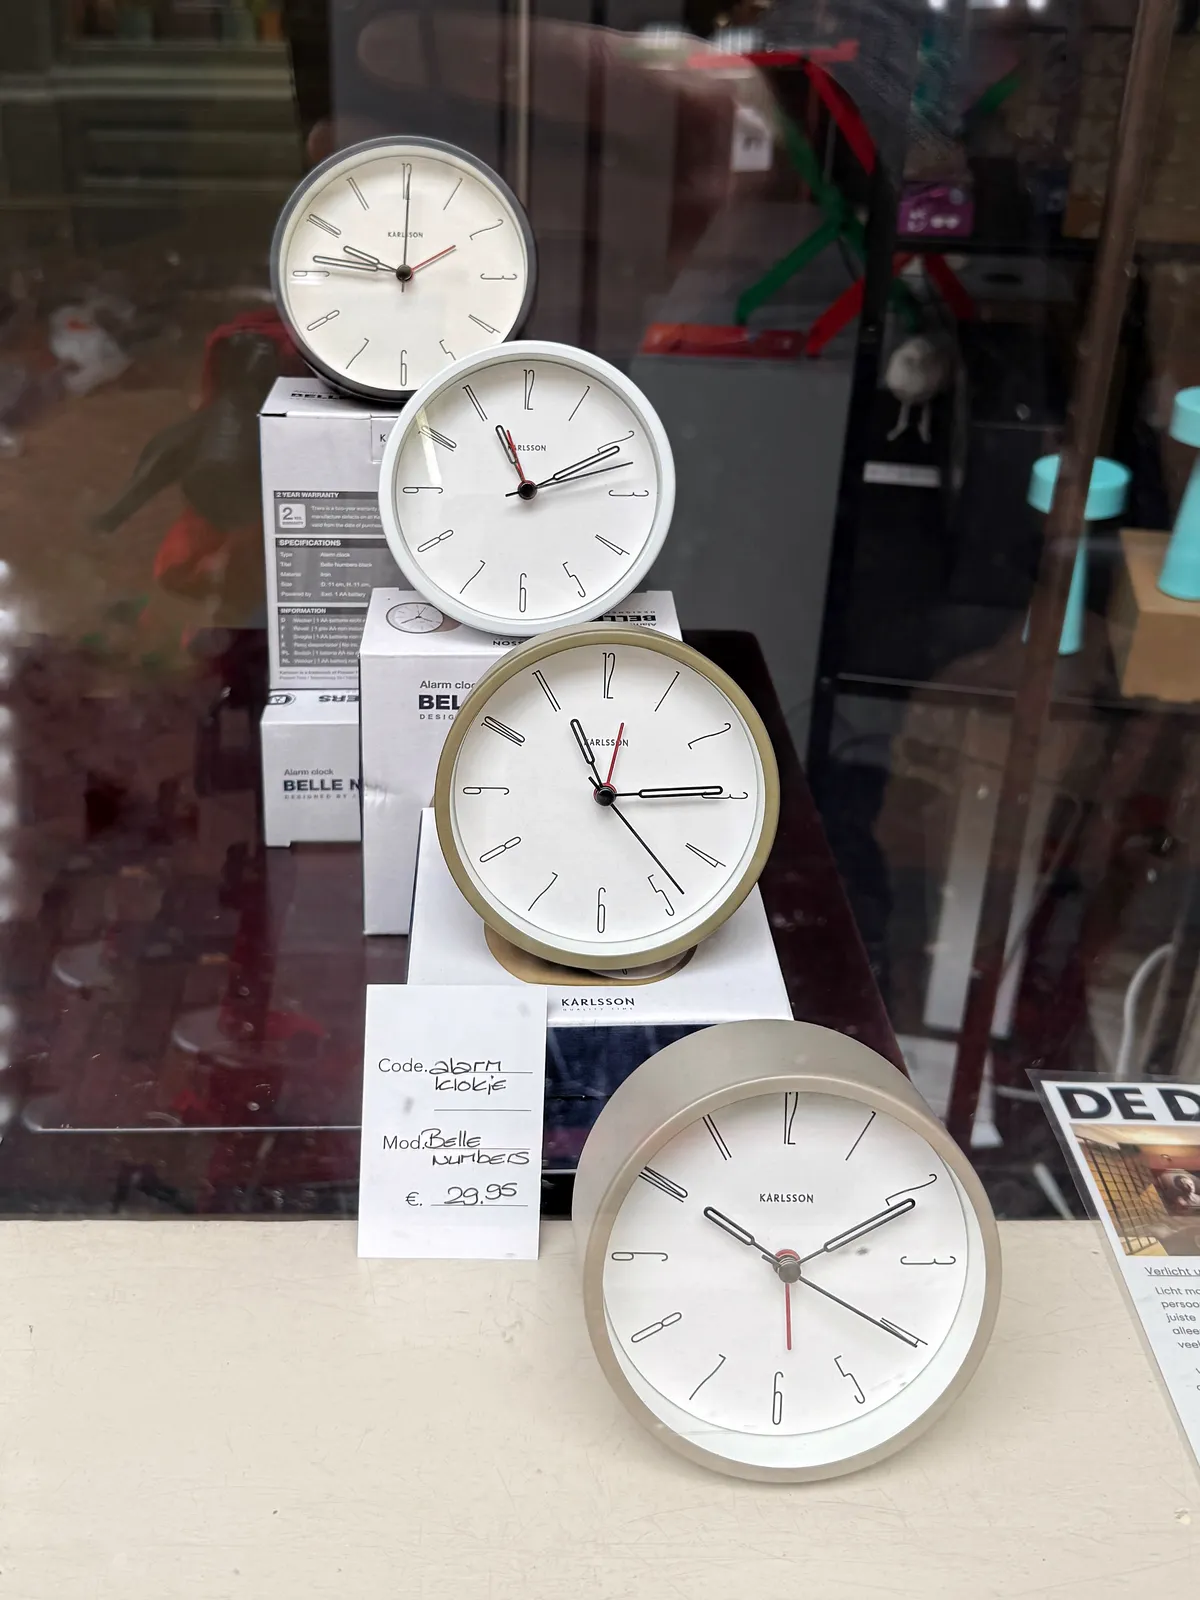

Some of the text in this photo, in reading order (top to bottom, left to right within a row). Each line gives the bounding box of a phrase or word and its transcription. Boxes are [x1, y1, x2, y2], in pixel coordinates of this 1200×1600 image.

[402, 163, 412, 200] 12
[443, 178, 463, 211] 1
[306, 213, 342, 239] 10
[469, 219, 504, 241] 2
[292, 270, 330, 278] 9
[306, 309, 340, 332] 8
[468, 314, 501, 334] 4
[345, 337, 370, 370] 7
[400, 349, 408, 387] 6
[462, 384, 488, 422] 11
[523, 369, 535, 411] 12
[568, 385, 591, 422] 1
[418, 425, 457, 452] 10
[597, 430, 635, 453] 2
[402, 486, 444, 495] 9
[608, 489, 650, 497] 3
[282, 507, 294, 520] 2
[279, 539, 342, 547] SPECIFICATIONS
[417, 529, 454, 553] 8
[594, 534, 631, 556] 4
[459, 559, 486, 595] 7
[562, 561, 586, 598] 5
[519, 572, 528, 613] 6
[419, 680, 452, 689] Alarm
[602, 652, 616, 700] 12
[418, 694, 461, 710] BEL
[531, 669, 562, 713] 11
[654, 670, 681, 713] 1
[480, 715, 526, 748] 10
[687, 722, 732, 750] 2
[283, 768, 334, 776] Alarm clock
[283, 779, 344, 791] BELLE
[462, 785, 510, 796] 9
[479, 836, 522, 864] 8
[685, 842, 727, 868] 4
[527, 871, 559, 912] 7
[647, 874, 675, 917] 5
[597, 887, 606, 934] 6
[561, 997, 635, 1007] KARLSSON
[378, 1057, 428, 1073] Code.
[1056, 1086, 1157, 1121] DE
[383, 1127, 482, 1150] Mod. Belle
[845, 1110, 877, 1162] 1
[443, 1182, 518, 1206] 29.95
[759, 1192, 815, 1204] KARLSSON
[885, 1173, 938, 1206] 2
[611, 1251, 669, 1262] 9
[900, 1256, 957, 1266] 3
[1144, 1266, 1192, 1276] Verlicht
[1154, 1286, 1183, 1295] Licht
[631, 1311, 683, 1344] 8
[1166, 1312, 1197, 1324] juiste
[879, 1317, 929, 1347] 4
[689, 1353, 727, 1401] 7
[834, 1355, 866, 1405] 5
[772, 1371, 784, 1426] 6
